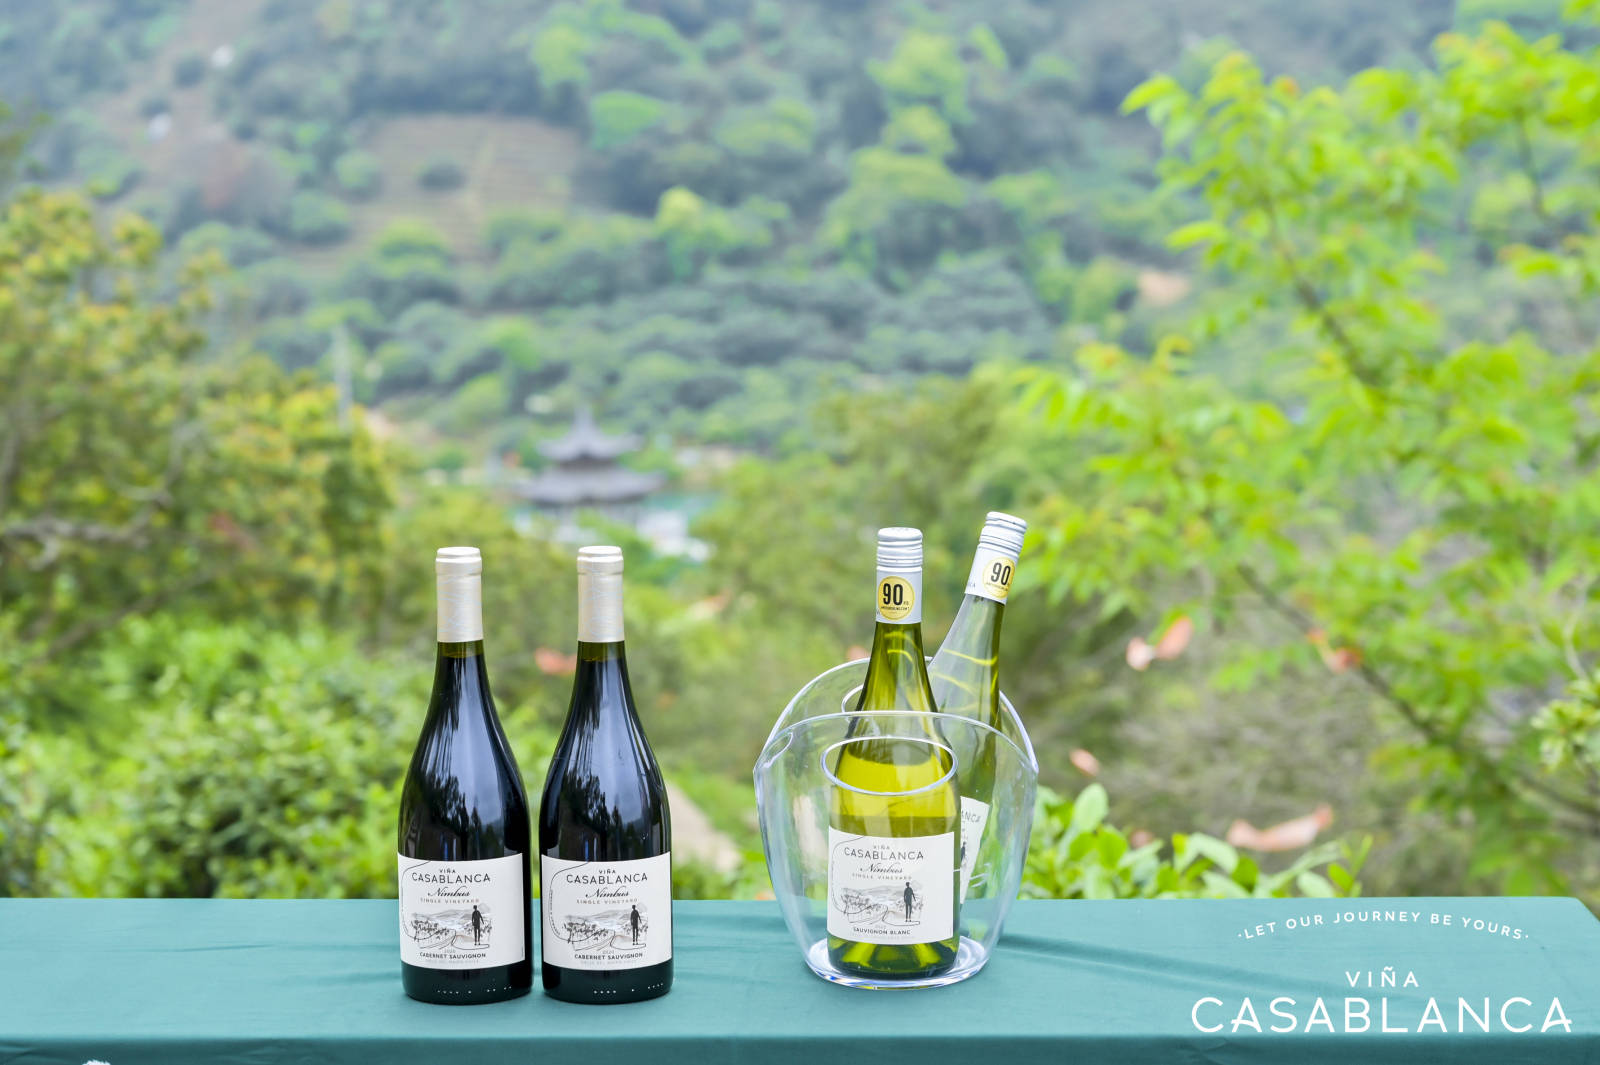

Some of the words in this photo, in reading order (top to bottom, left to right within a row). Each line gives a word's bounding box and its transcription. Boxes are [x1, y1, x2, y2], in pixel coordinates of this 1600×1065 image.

[991, 562, 1011, 586] 90
[883, 582, 904, 606] 90
[844, 847, 924, 860] CASABLANCA
[859, 862, 903, 874] Nimbus
[411, 872, 491, 884] CASABLANCA
[566, 872, 648, 885] CASABLANCA
[427, 885, 471, 898] Nimbus
[585, 885, 629, 898] Nimbus
[853, 926, 888, 935] SAUVIGNON
[419, 951, 447, 959] CABERNET
[449, 952, 486, 960] SAUVIGNON
[574, 953, 605, 961] CABERNET
[607, 952, 643, 961] SAUVIGNON
